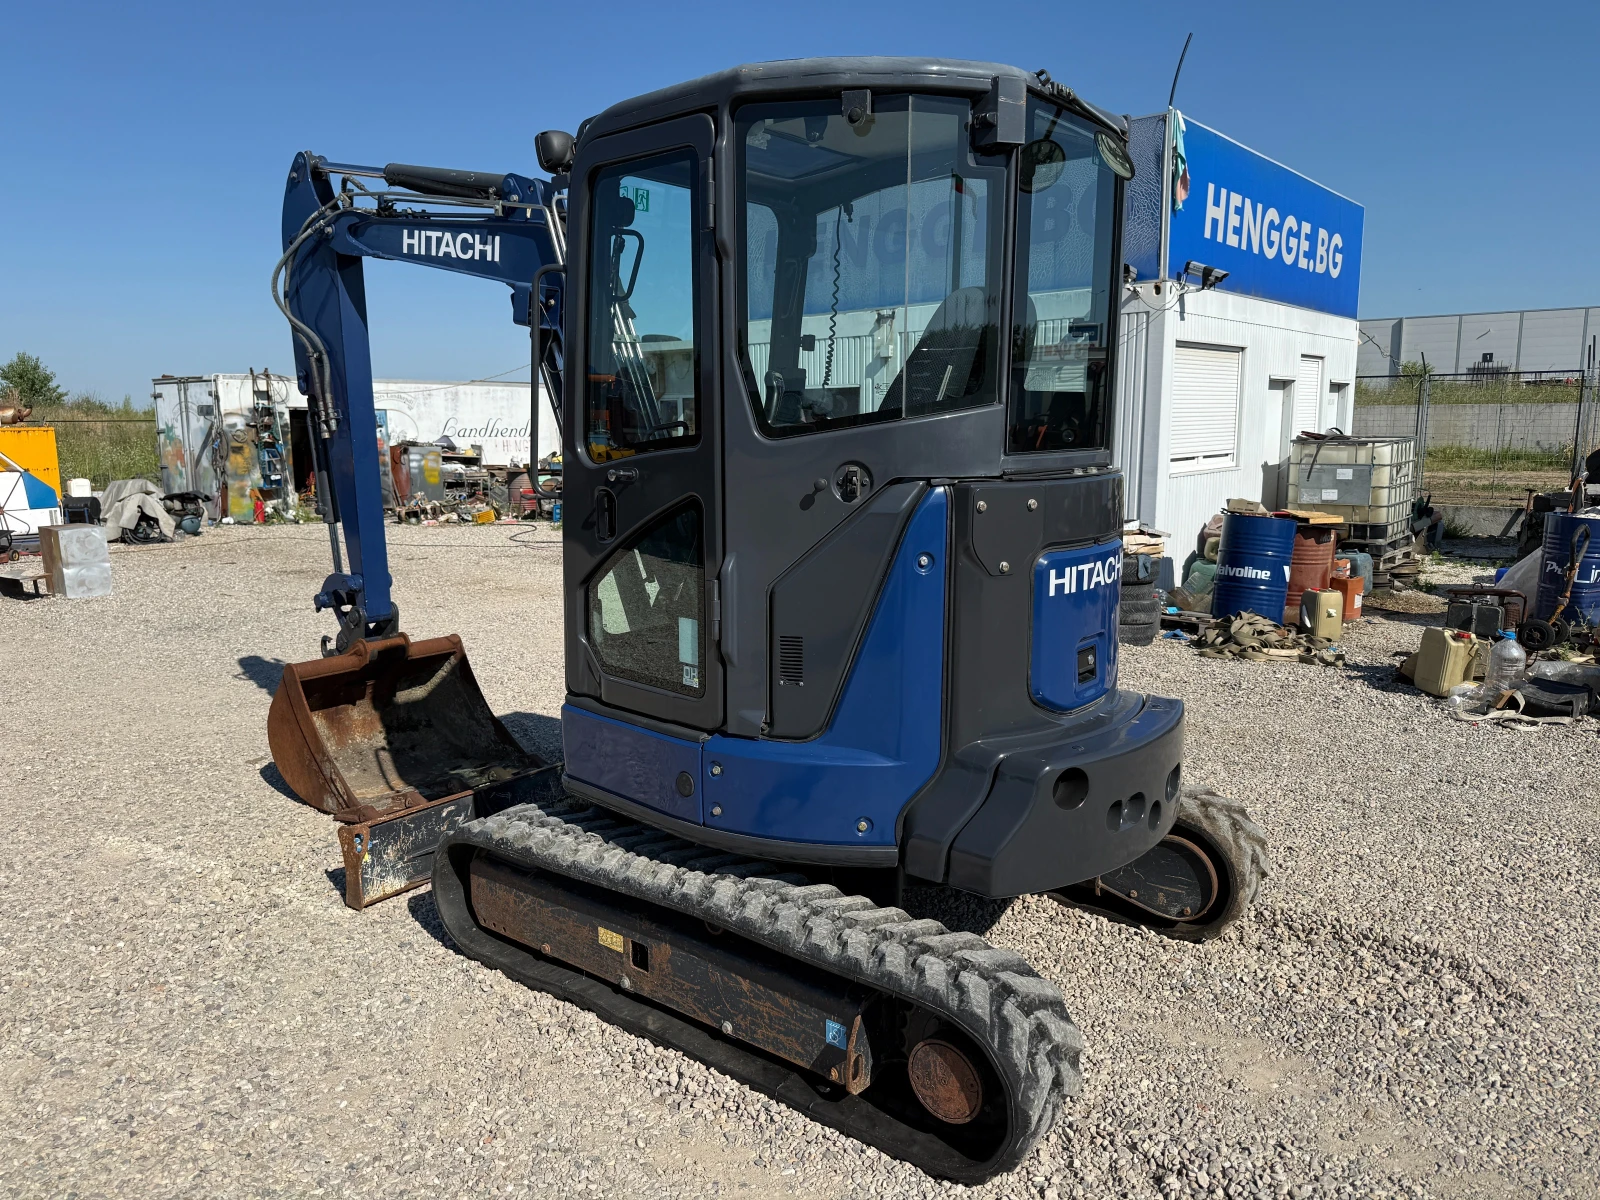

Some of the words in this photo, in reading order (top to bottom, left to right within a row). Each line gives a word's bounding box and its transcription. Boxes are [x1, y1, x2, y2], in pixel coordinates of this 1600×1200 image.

[402, 229, 501, 262] HITACHI
[1203, 182, 1344, 279] HENGGE.BG
[441, 416, 531, 438] Landhend
